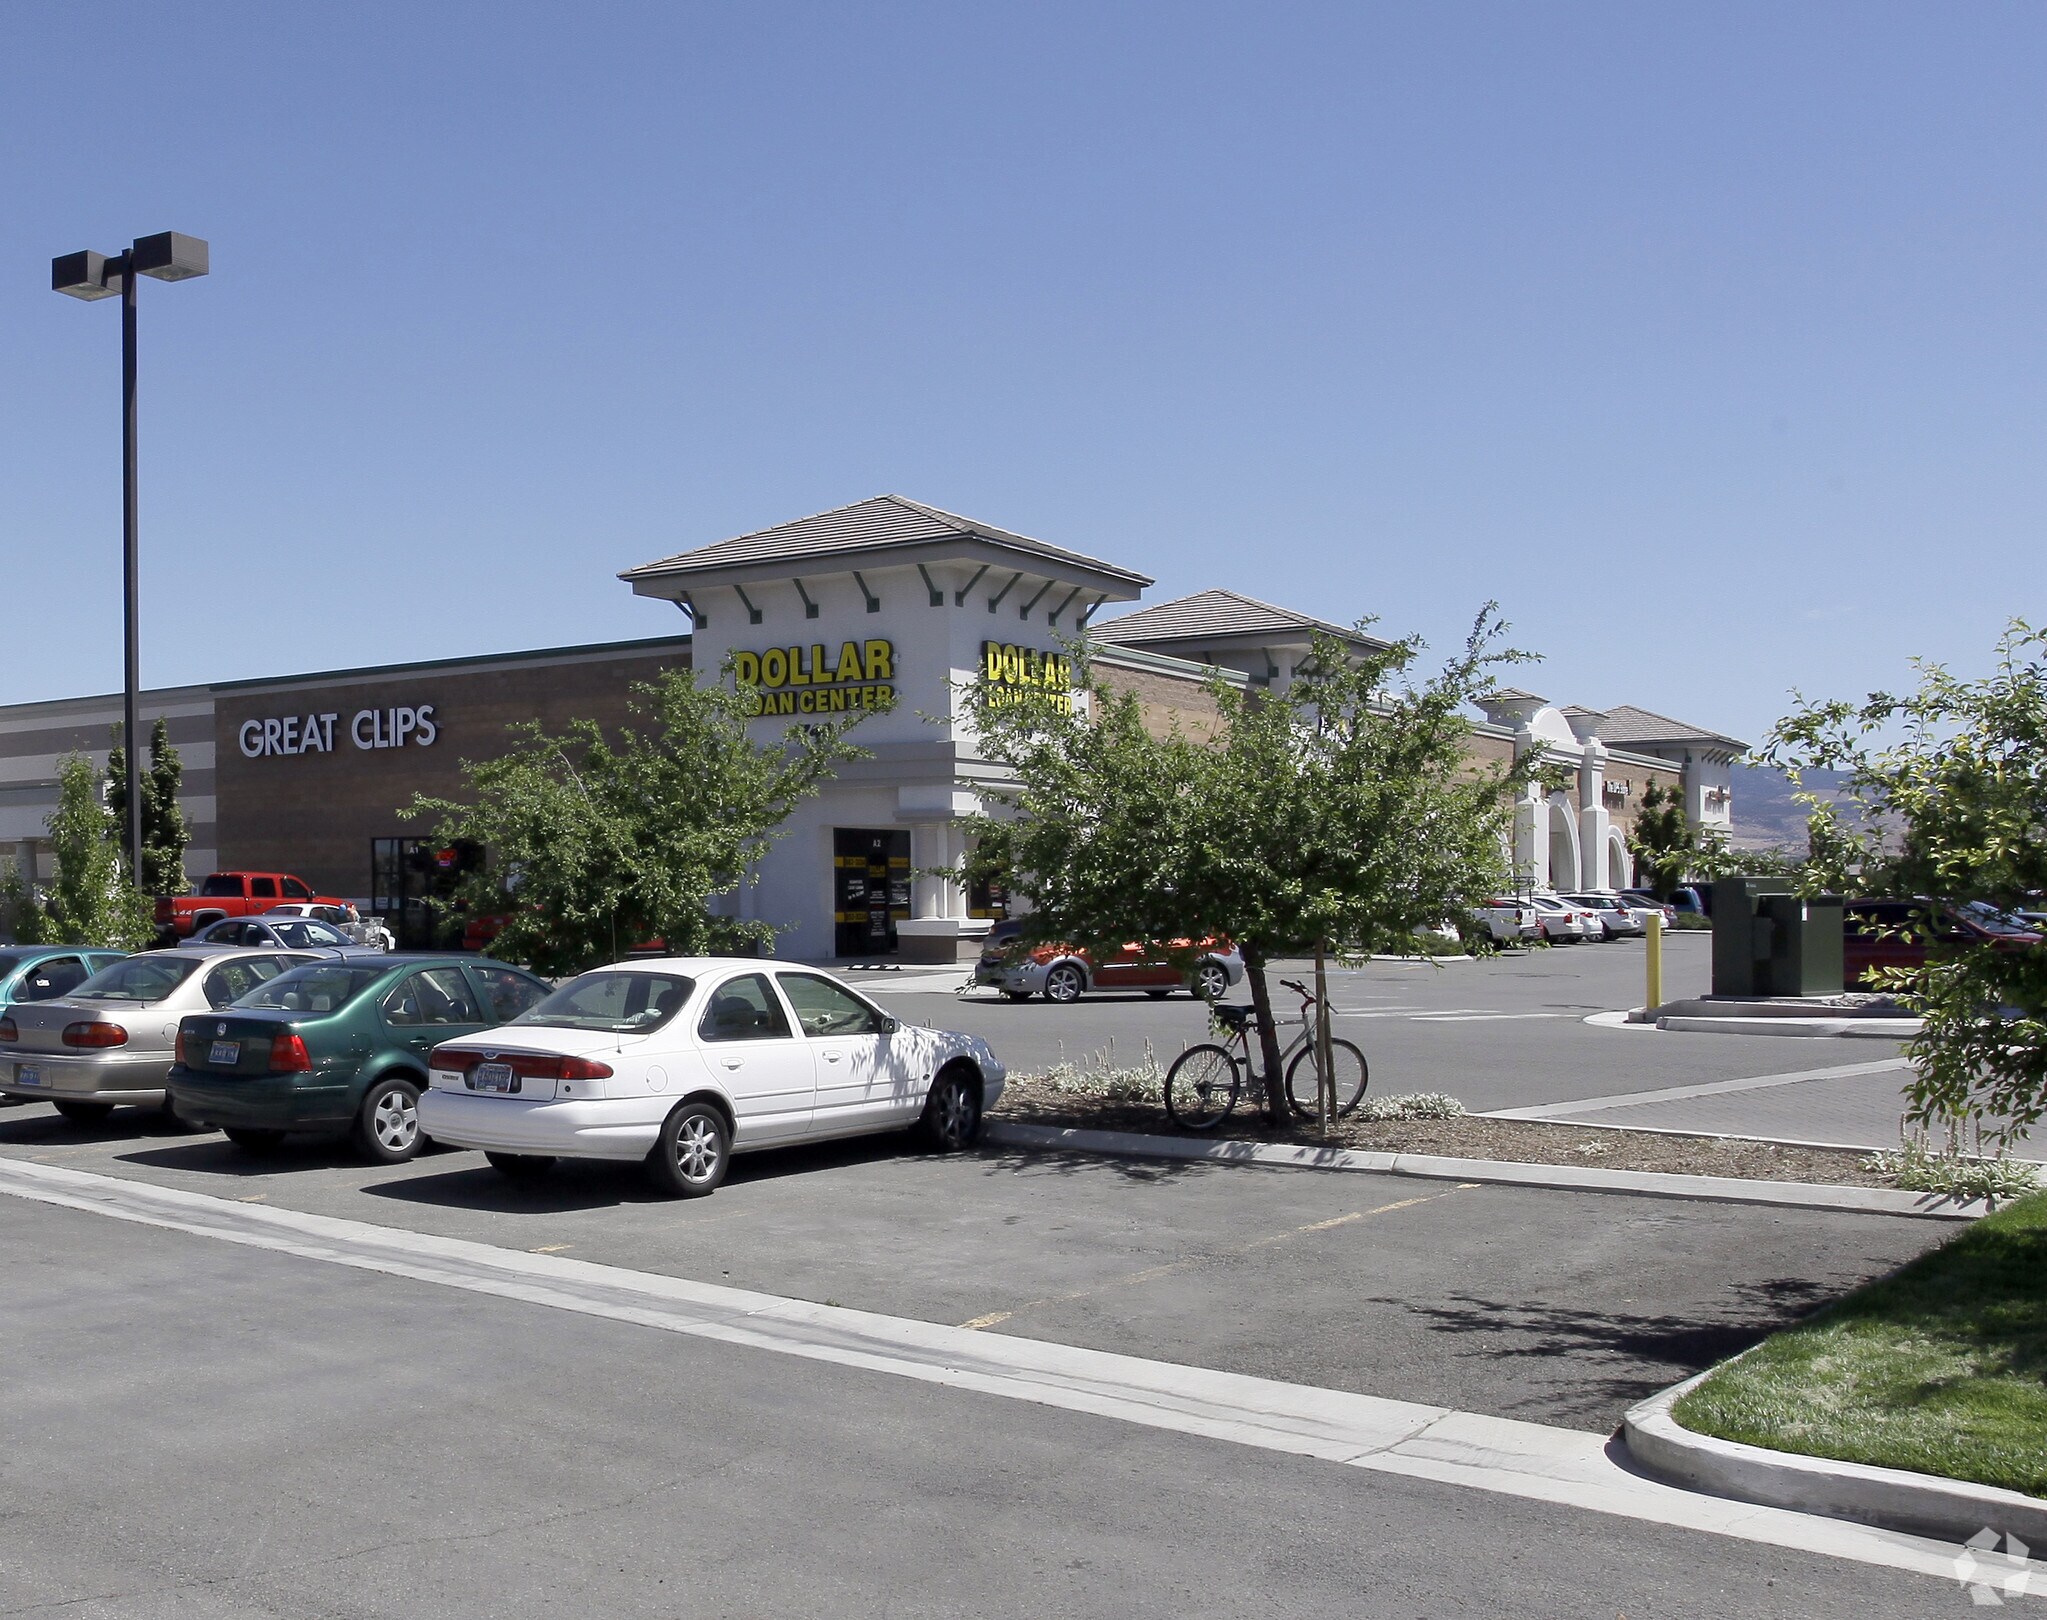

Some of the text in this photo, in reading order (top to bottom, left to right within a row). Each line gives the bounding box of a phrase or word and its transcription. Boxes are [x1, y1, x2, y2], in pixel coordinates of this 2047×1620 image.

[735, 639, 893, 689] DOLLAR
[984, 641, 1071, 692] DOLLAR
[799, 685, 893, 714] CENTER
[238, 704, 437, 758] GREAT CLIPS
[409, 846, 419, 854] A1
[872, 839, 881, 848] A2
